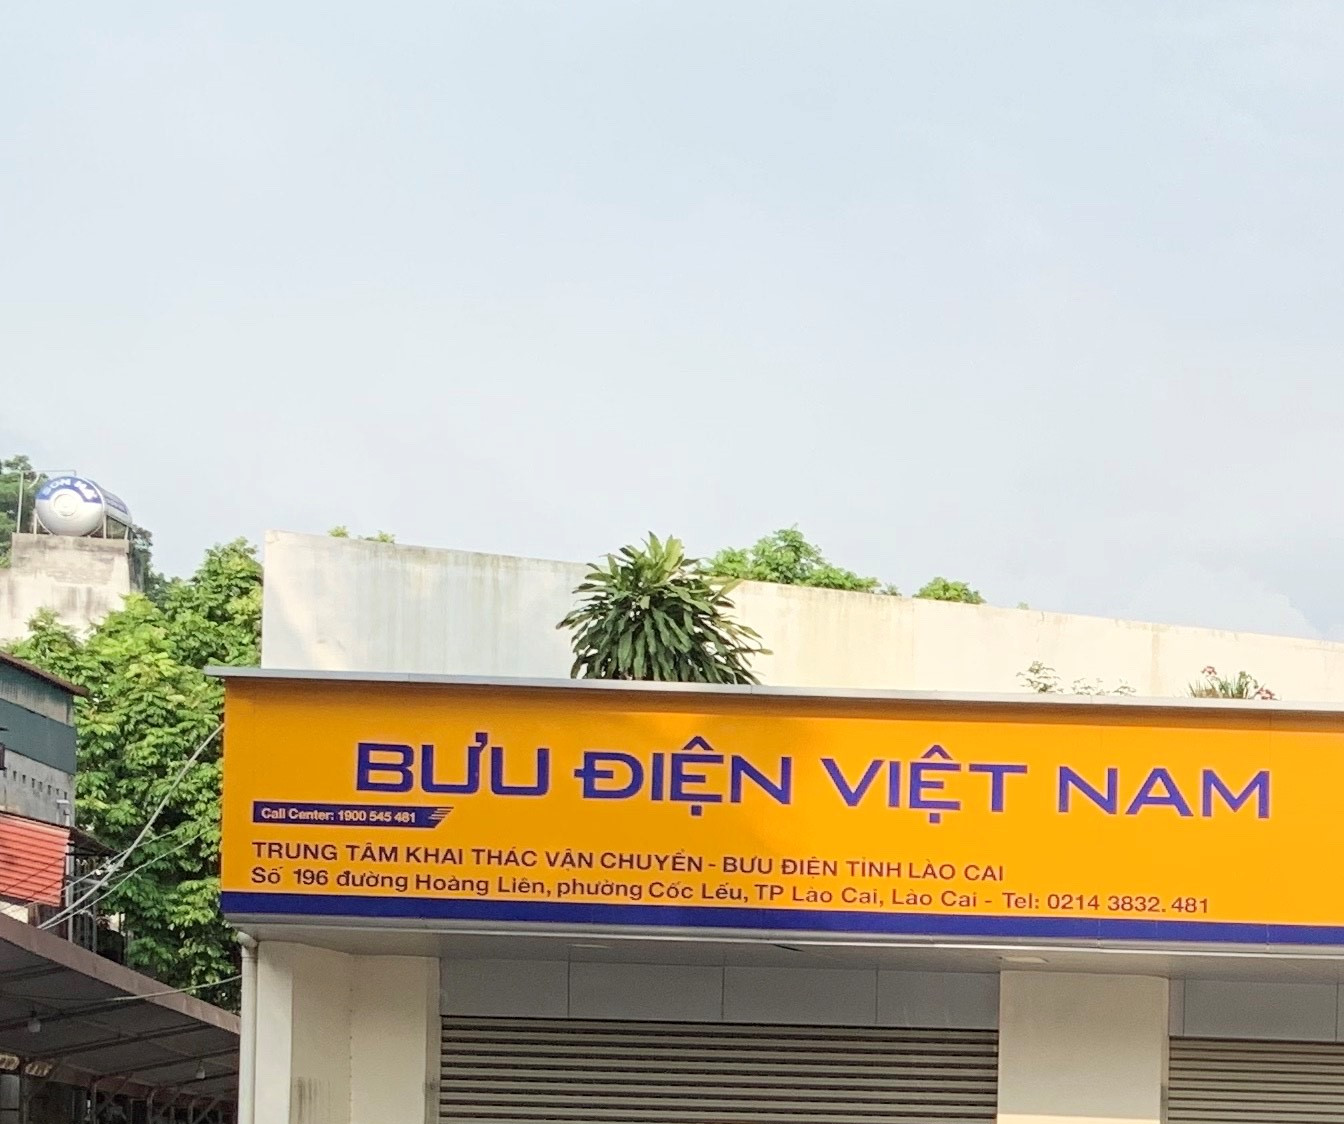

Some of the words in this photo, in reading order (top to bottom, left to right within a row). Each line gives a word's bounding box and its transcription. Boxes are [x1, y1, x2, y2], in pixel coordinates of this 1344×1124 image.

[356, 732, 550, 796] BƯU
[574, 736, 792, 816] ĐIỆN
[820, 744, 1027, 823] VIỆT
[1059, 766, 1269, 819] NAM
[261, 807, 285, 820] Call
[338, 809, 366, 821] 1900
[369, 810, 393, 822] 545
[395, 811, 416, 823] 481
[252, 842, 338, 861] TRUNG
[346, 842, 398, 863] TÂM
[405, 846, 463, 864] KHAI
[472, 845, 537, 867] THÁC
[545, 848, 593, 872] VẬN
[600, 848, 702, 873] CHUYỂN
[723, 854, 773, 874] BƯU
[781, 856, 838, 879] ĐIỆN
[846, 856, 901, 879] TỈNH
[908, 858, 955, 880] LÀO
[964, 865, 1003, 881] CAI
[252, 866, 283, 884] Số
[293, 868, 328, 886] 196
[336, 870, 408, 892] đường
[415, 873, 489, 895] Hoàng
[498, 877, 552, 897] Liên,
[557, 879, 642, 900] phường
[649, 880, 693, 899] Cốc
[702, 882, 748, 902] Lếu,
[754, 884, 784, 901] TP
[792, 886, 833, 904] Lào
[841, 888, 884, 907] Cai,
[892, 889, 932, 906] Lào
[941, 891, 977, 907] Cai
[1002, 892, 1039, 910] Tel:
[1047, 894, 1099, 911] 0214
